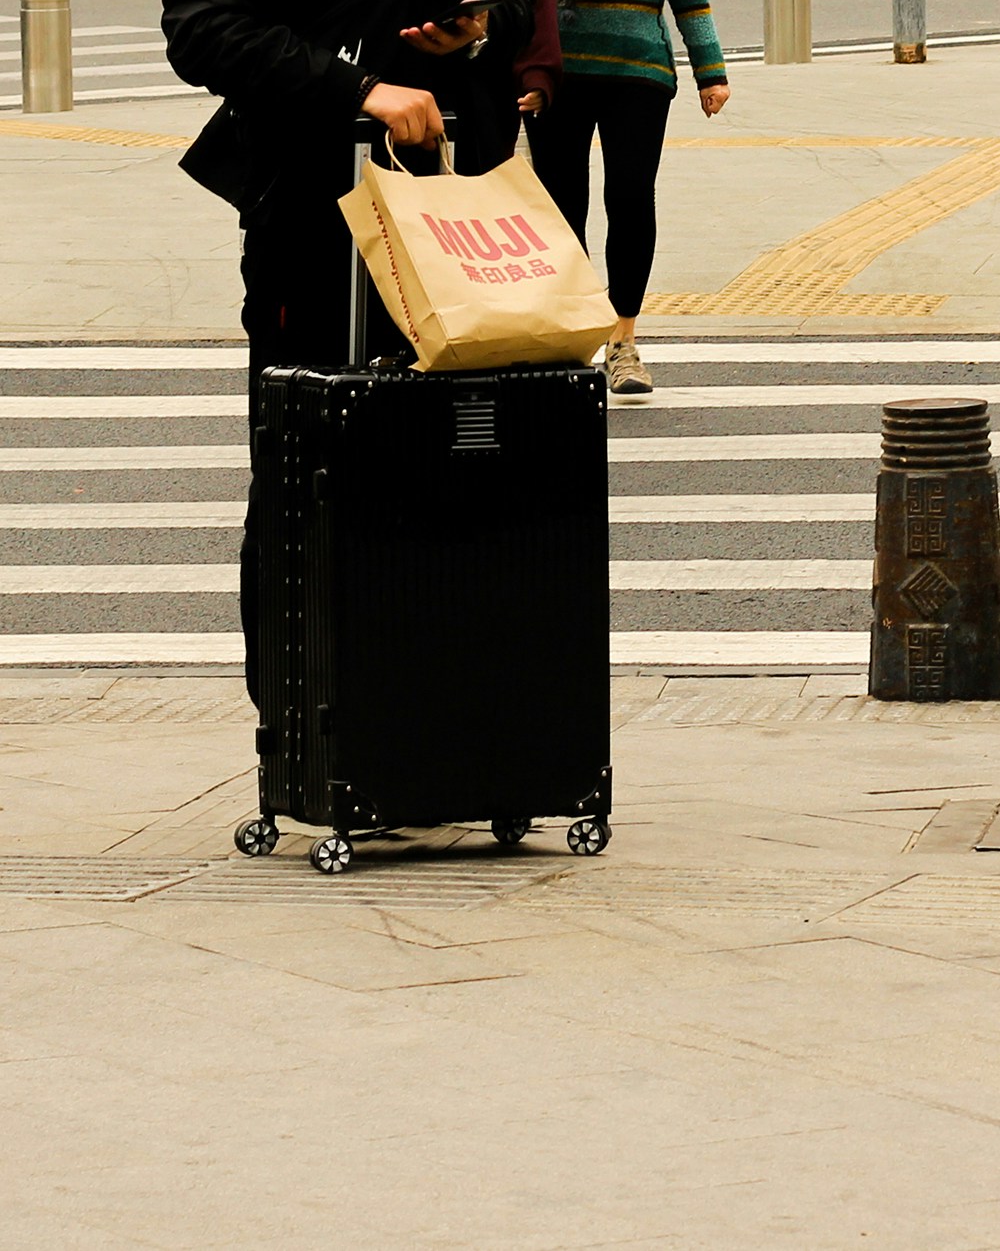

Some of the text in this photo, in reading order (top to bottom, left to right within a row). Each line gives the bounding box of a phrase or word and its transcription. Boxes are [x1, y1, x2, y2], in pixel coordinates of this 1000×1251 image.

[420, 212, 550, 261] MUJI
[460, 259, 558, 285] 無印良品
